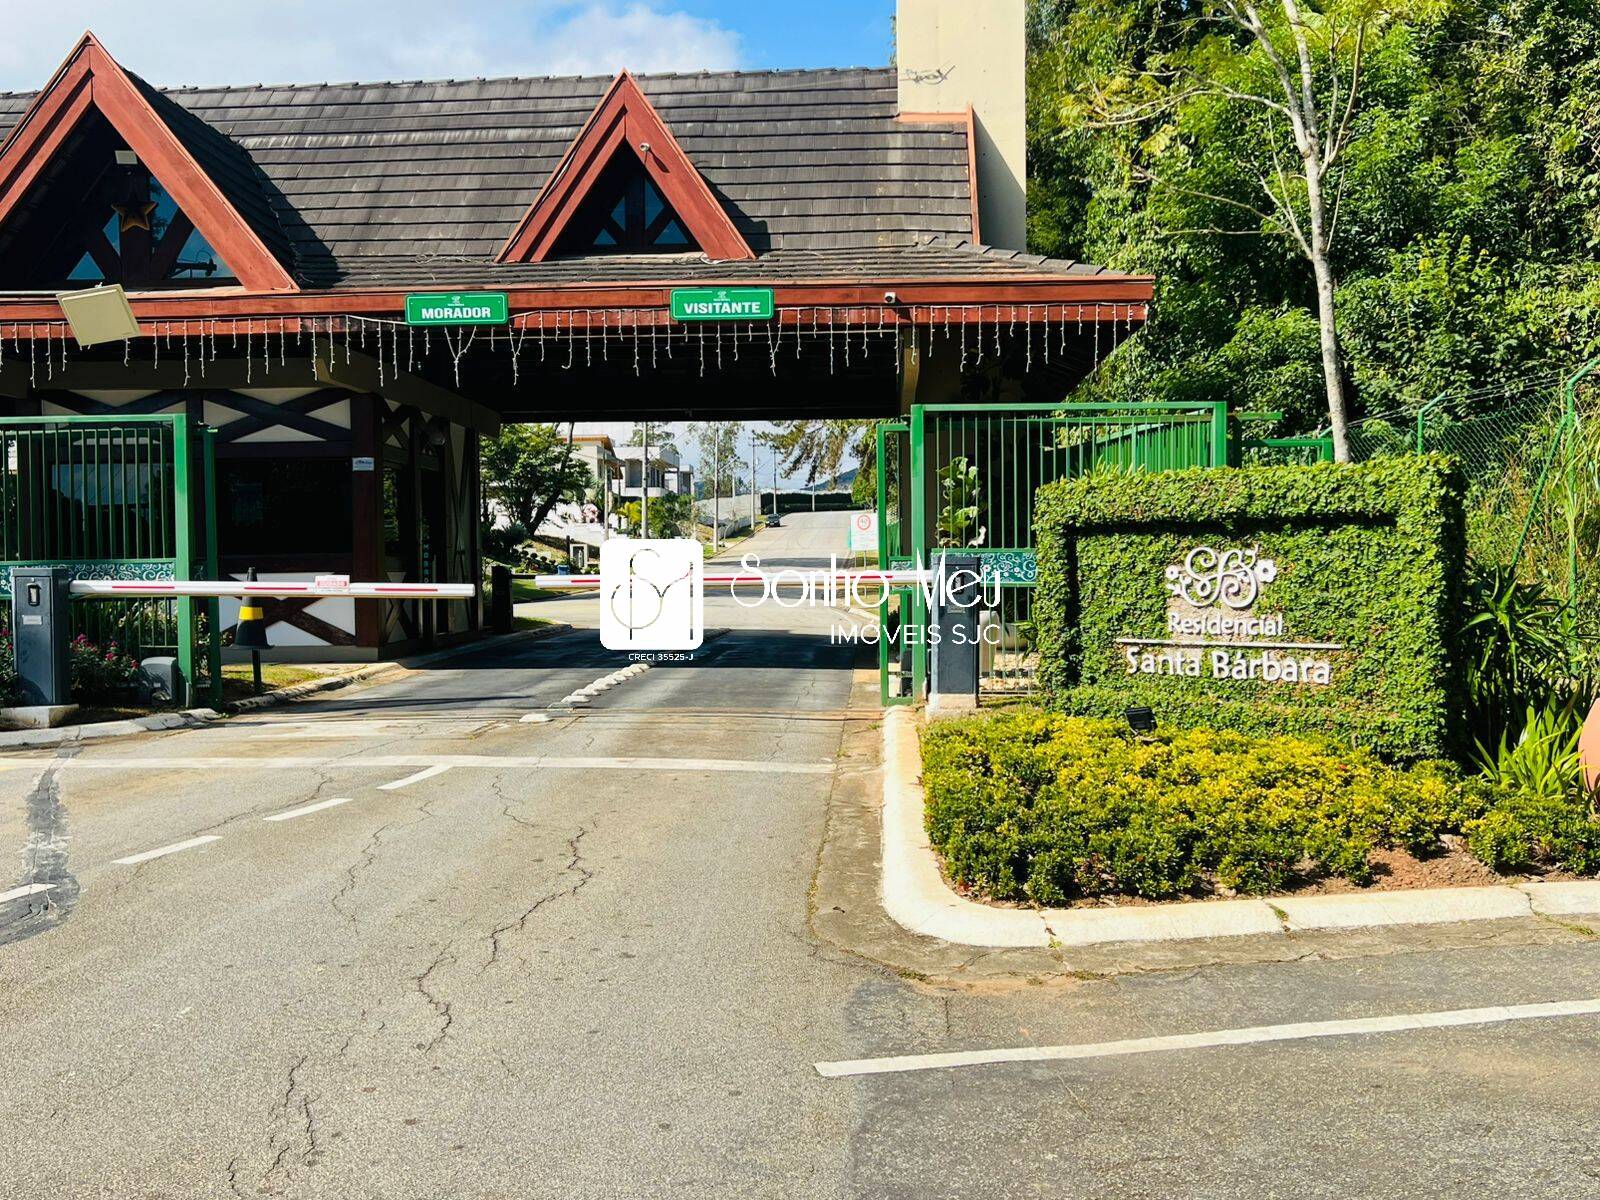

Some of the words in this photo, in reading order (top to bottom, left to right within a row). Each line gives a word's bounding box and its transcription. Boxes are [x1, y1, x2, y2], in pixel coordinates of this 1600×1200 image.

[421, 307, 491, 319] MORADOR
[683, 302, 761, 314] VISITANTE
[1168, 612, 1283, 635] Residencial
[1126, 646, 1201, 677] Santa
[1211, 650, 1331, 685] Bárbara
